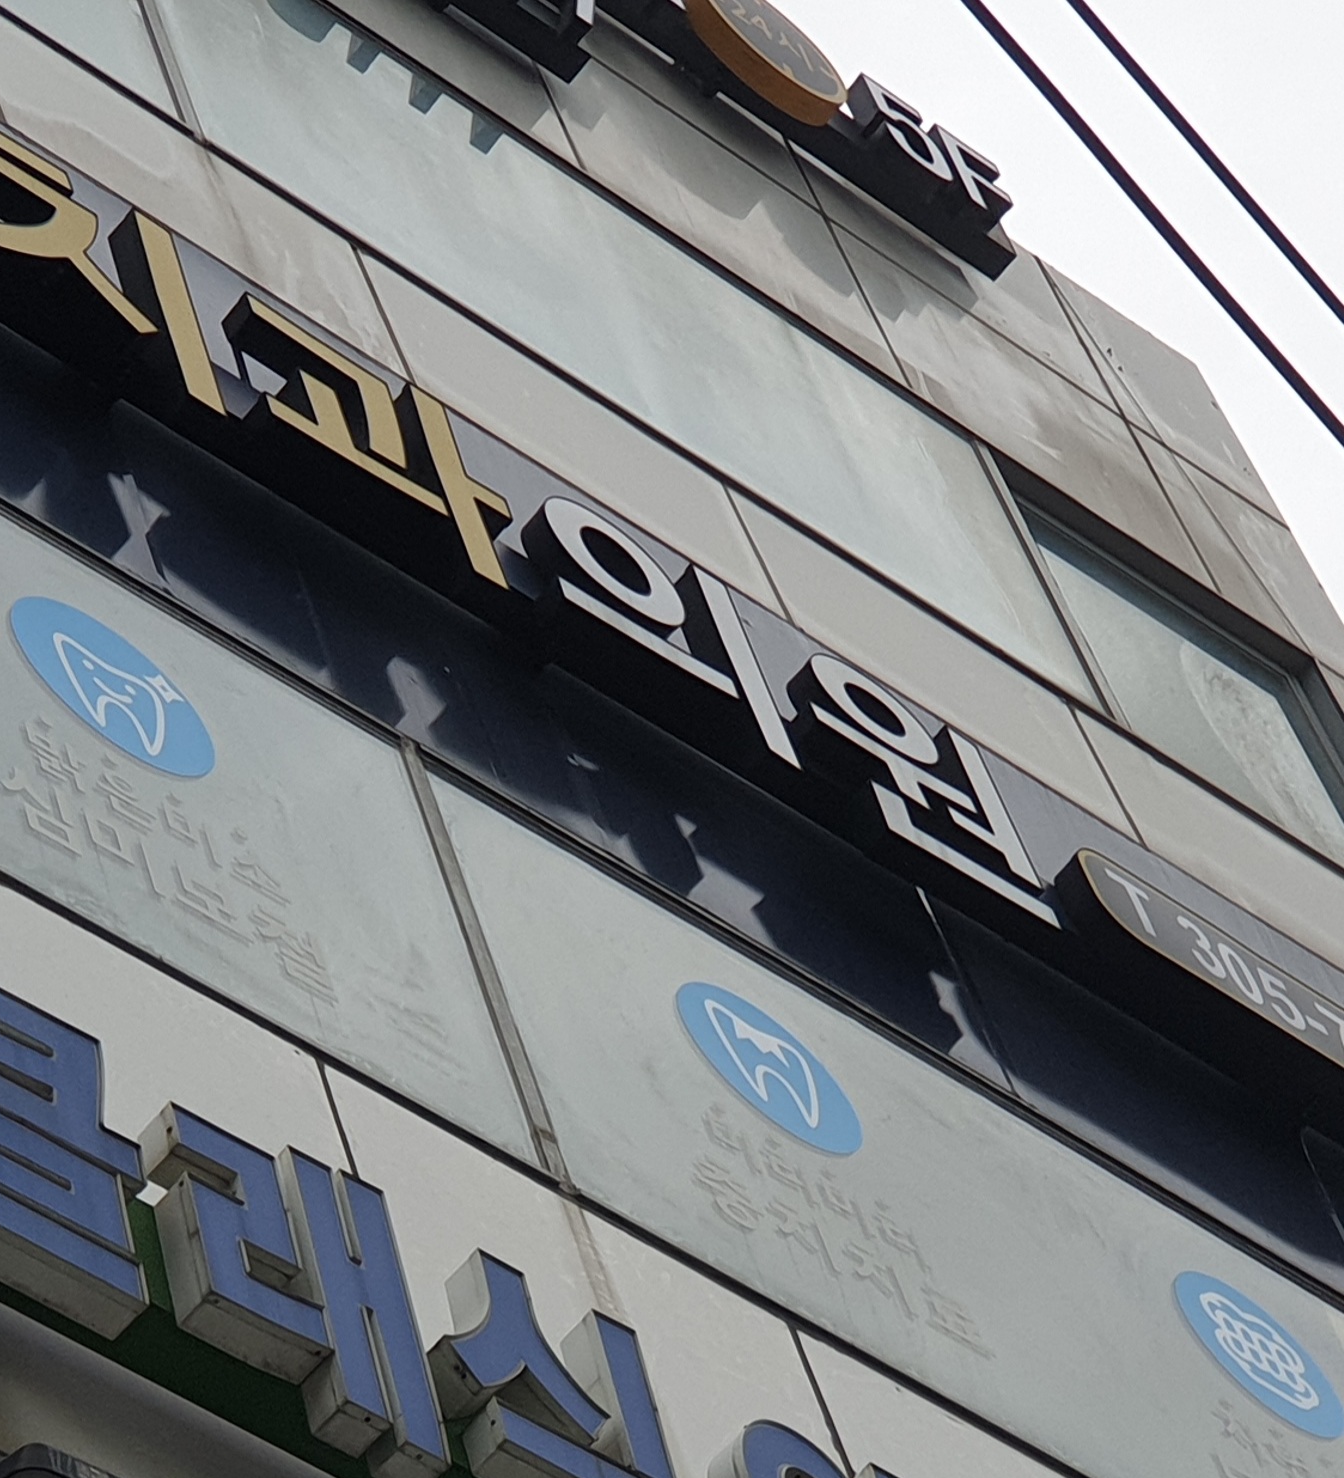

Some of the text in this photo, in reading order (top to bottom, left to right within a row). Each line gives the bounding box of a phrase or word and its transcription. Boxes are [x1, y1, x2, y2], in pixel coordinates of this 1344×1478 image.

[853, 72, 1013, 212] 5F
[1105, 867, 1156, 937] T
[691, 1152, 998, 1362] 충치치료
